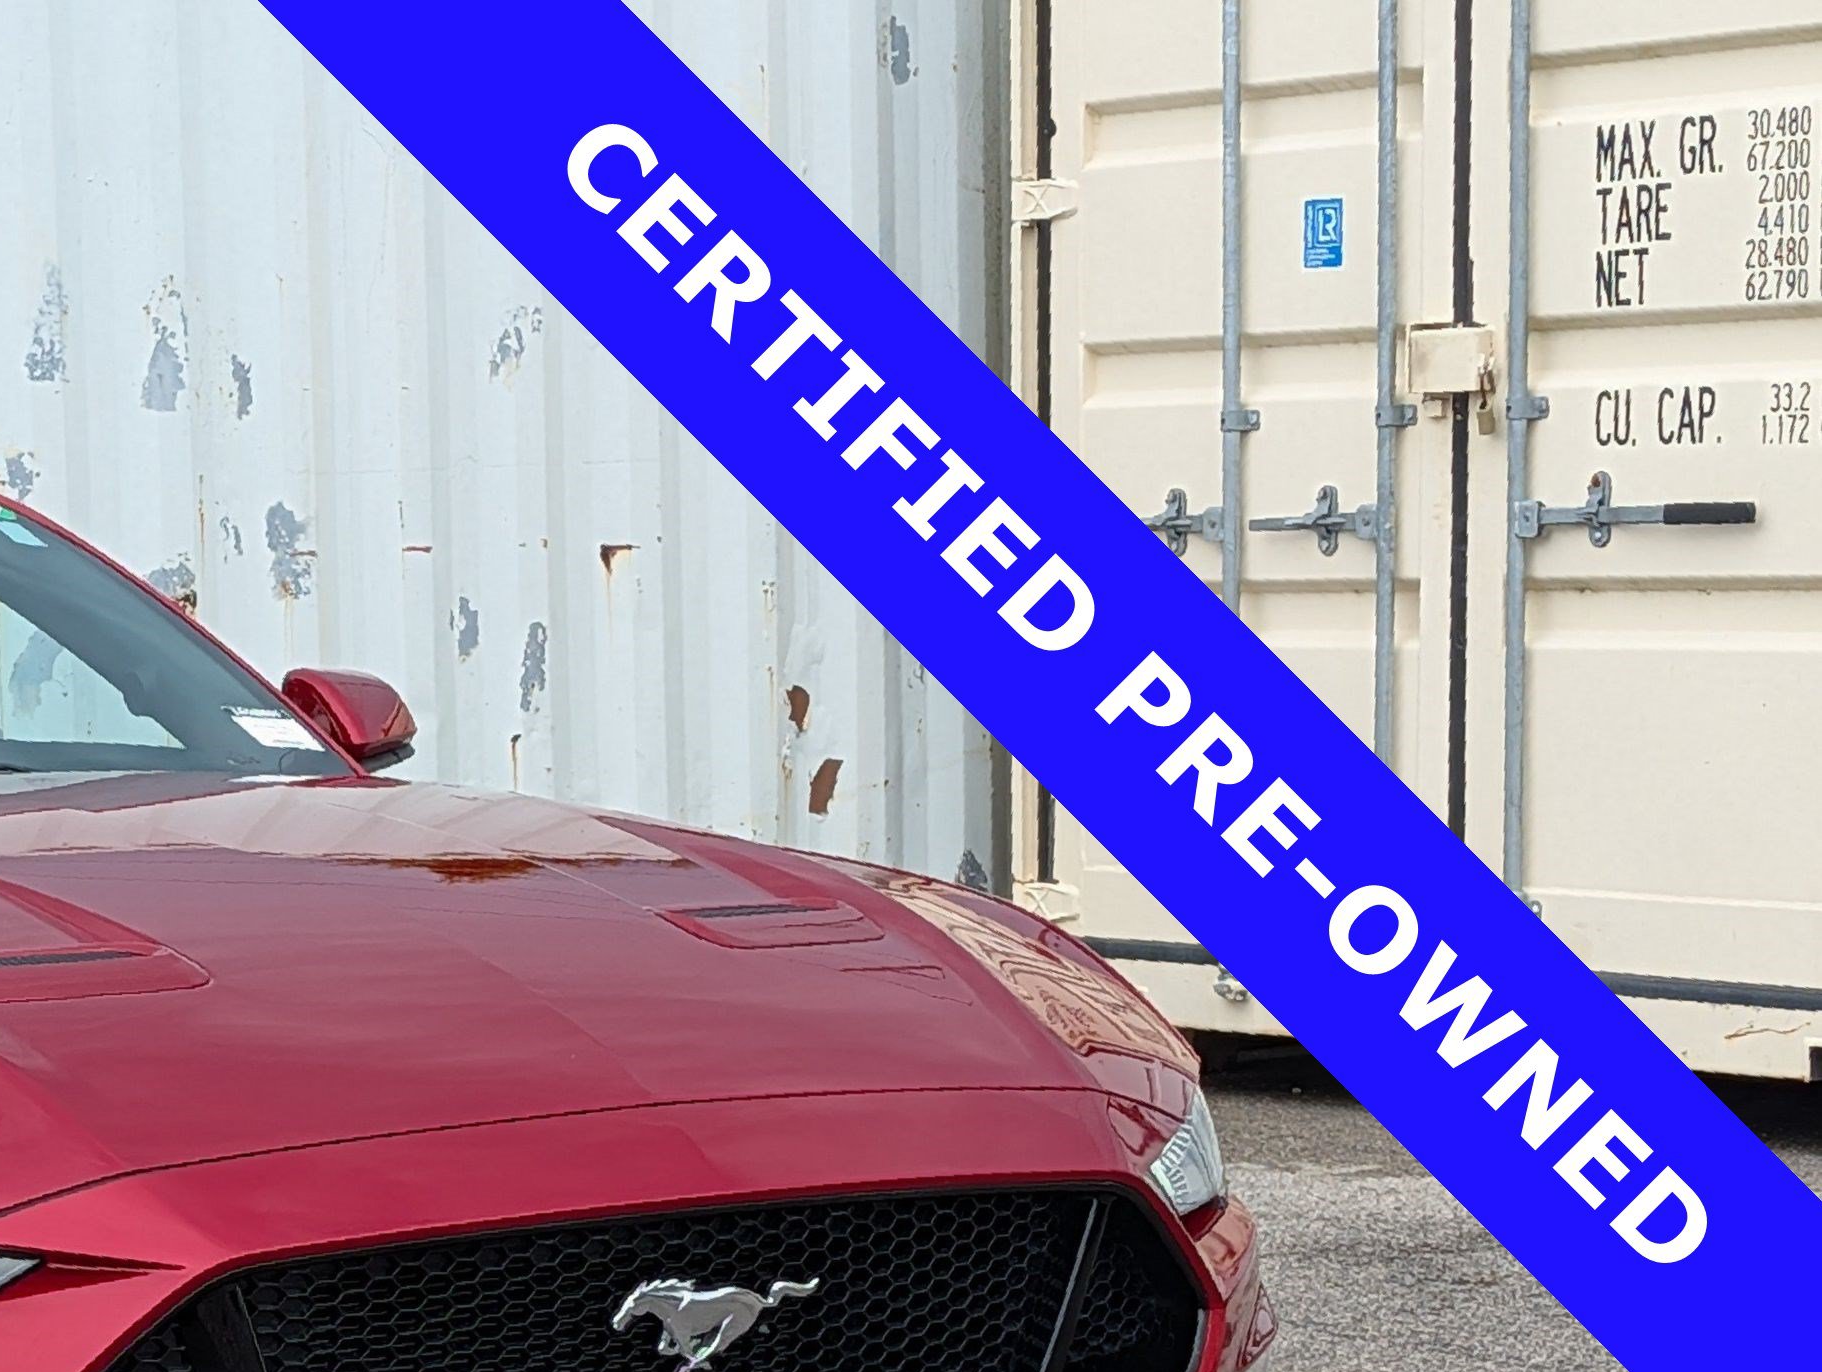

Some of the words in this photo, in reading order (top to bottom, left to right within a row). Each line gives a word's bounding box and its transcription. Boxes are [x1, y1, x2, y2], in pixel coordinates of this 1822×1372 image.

[1747, 106, 1811, 139] 30.480
[1596, 120, 1661, 183] MAX.
[1679, 115, 1723, 174] GR.
[1747, 138, 1811, 172] 67.200
[1596, 182, 1672, 245] TARE
[1745, 236, 1808, 269] 28.480
[1596, 248, 1649, 307] NET
[1770, 381, 1811, 413] 33.2
[1595, 388, 1636, 447] CU.
[1657, 386, 1721, 445] CAP.
[1762, 414, 1809, 444] 1.172
